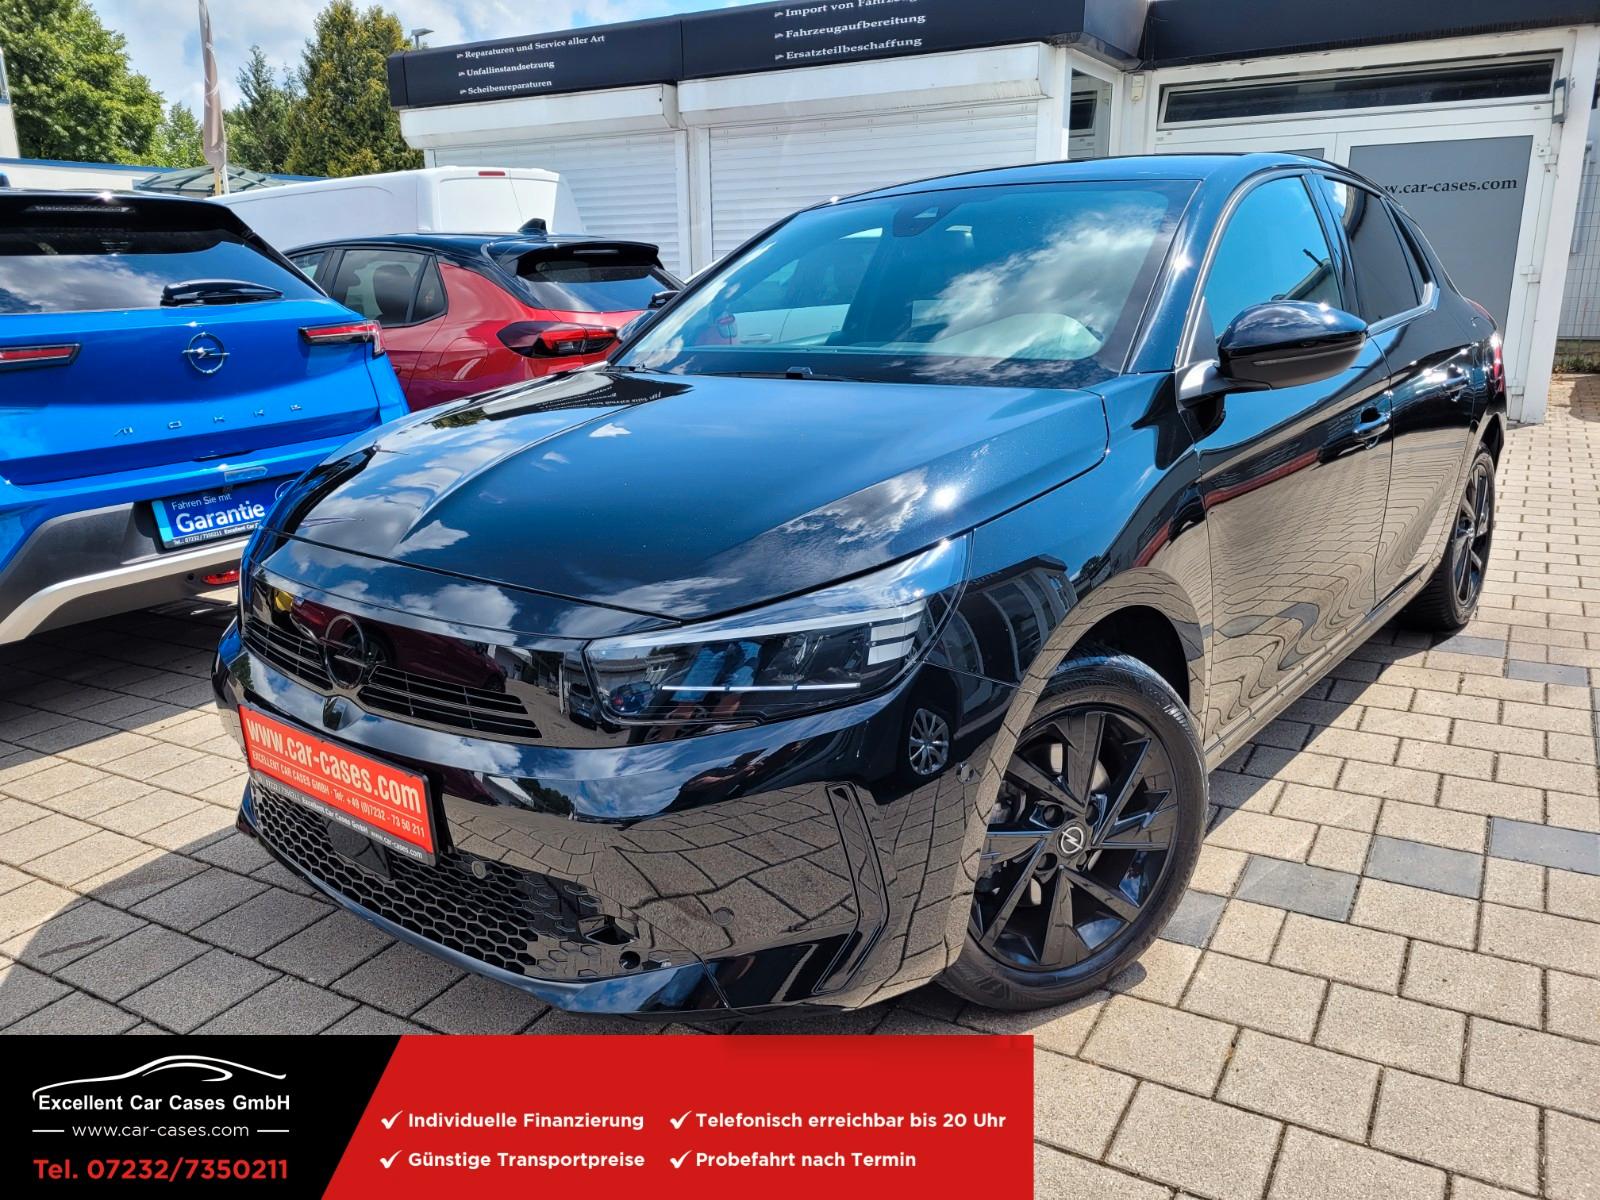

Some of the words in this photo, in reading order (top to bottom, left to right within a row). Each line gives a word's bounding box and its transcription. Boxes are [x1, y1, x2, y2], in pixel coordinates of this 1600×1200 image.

[786, 4, 828, 20] Import
[831, 2, 854, 10] von
[786, 14, 926, 38] Fahrzeugaufbereitung
[465, 46, 514, 59] Reparaturen
[516, 42, 534, 52] und
[535, 40, 566, 50] Service
[568, 36, 588, 46] aller
[590, 34, 605, 44] Art
[786, 38, 922, 60] Ersatzteilbeschaffung
[466, 60, 555, 77] Unfallinstandsetzung
[468, 80, 552, 95] Scheibenreparaturen
[171, 498, 202, 511] Fahren
[203, 496, 216, 505] Sie
[218, 493, 232, 502] mit
[176, 500, 266, 532] Garantie
[246, 718, 422, 814] www.car-cases.com
[252, 750, 280, 772] EXCELLENT
[280, 764, 292, 778] CAR
[292, 768, 311, 787] CASES
[391, 814, 400, 828] 73
[412, 824, 425, 838] 211
